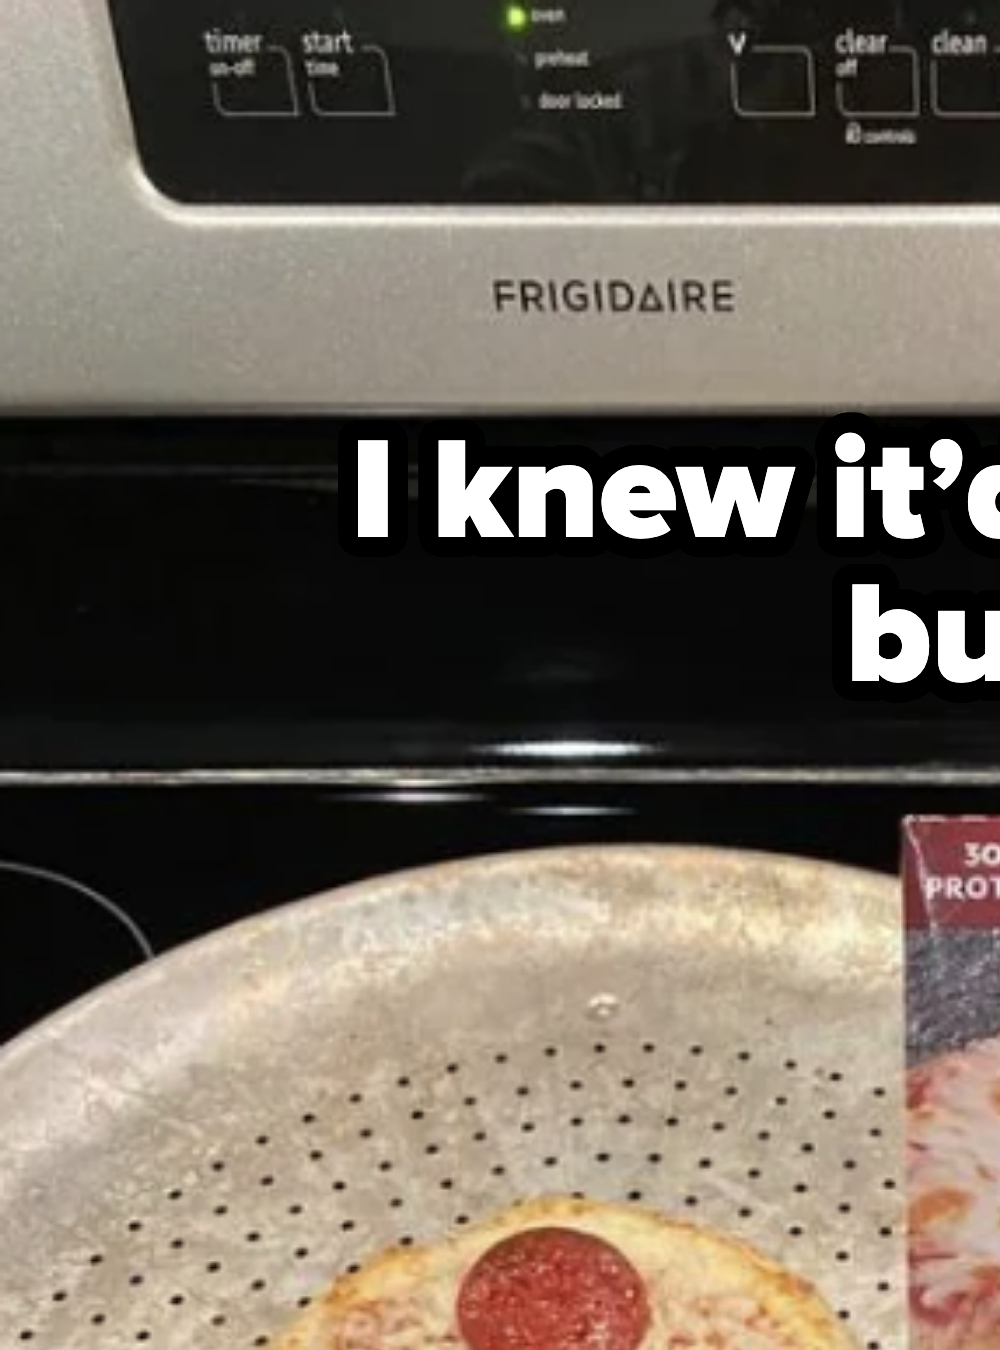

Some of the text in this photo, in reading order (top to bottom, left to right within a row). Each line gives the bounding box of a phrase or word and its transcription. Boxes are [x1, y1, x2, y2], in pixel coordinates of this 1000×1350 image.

[204, 29, 263, 54] timer
[302, 29, 353, 53] start
[835, 28, 887, 55] clear
[932, 28, 987, 55] clean
[209, 59, 254, 77] on-off
[306, 60, 339, 77] time
[836, 59, 858, 77] off
[493, 280, 735, 313] FRIGIDAIRE
